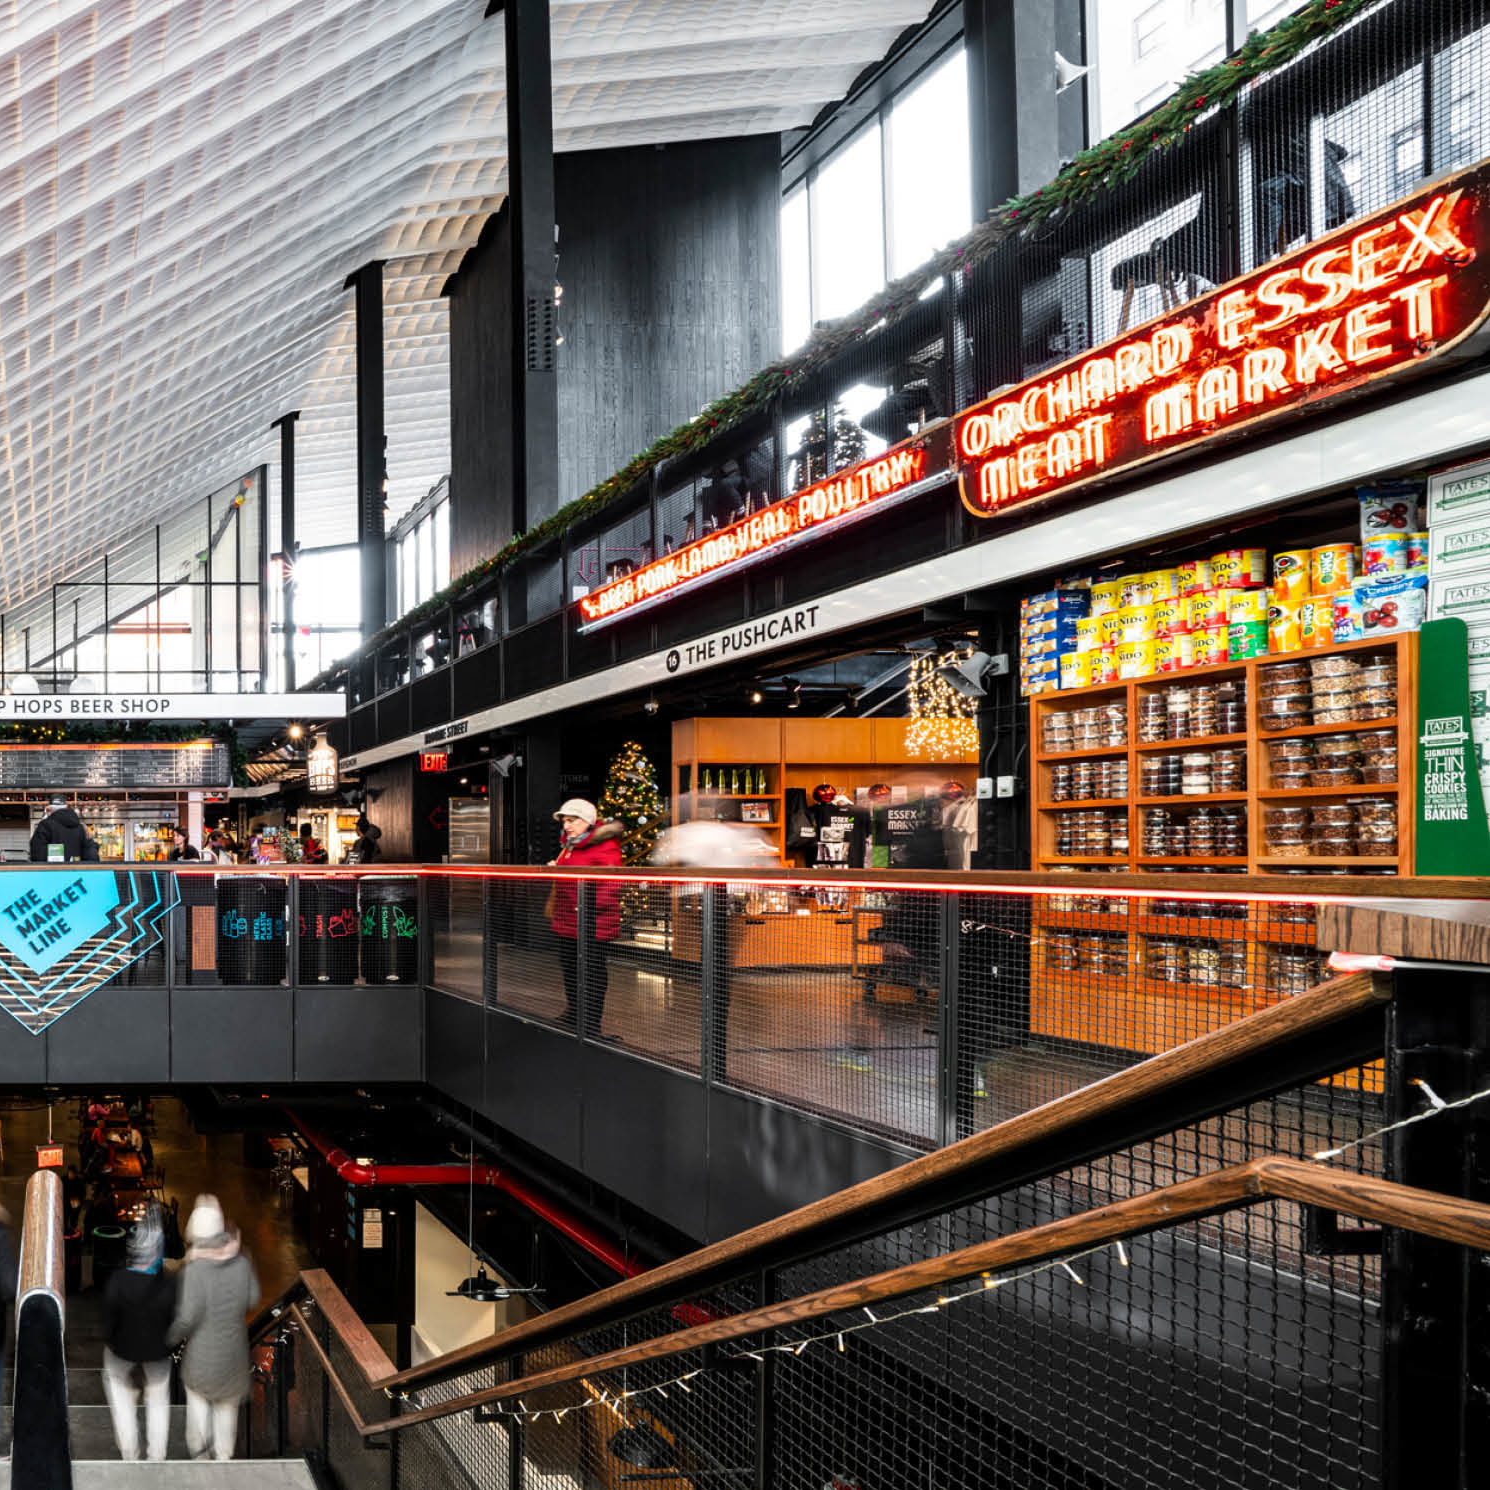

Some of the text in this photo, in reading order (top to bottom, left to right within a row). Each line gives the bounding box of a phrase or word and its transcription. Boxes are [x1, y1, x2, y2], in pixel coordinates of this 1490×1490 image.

[961, 187, 1472, 457] ORCHARD ESSEX
[980, 275, 1449, 504] MEAT MARKET
[798, 450, 926, 529] POULTRY
[668, 606, 820, 669] 16 THE PUSHCART
[13, 699, 63, 714] HOPS
[70, 699, 114, 714] BEER
[120, 698, 171, 713] SHOP
[424, 753, 445, 770] EXIT
[1424, 756, 1464, 773] THIN
[1424, 771, 1466, 785] CRISPY
[1424, 782, 1467, 794] COOKIES
[888, 809, 918, 820] ESSEX
[1424, 807, 1468, 821] BAKING
[2, 887, 42, 922] THE
[16, 876, 88, 939] MARKET
[28, 917, 72, 956] LINE
[315, 914, 323, 938] TRASH
[381, 906, 389, 939] COMPOST
